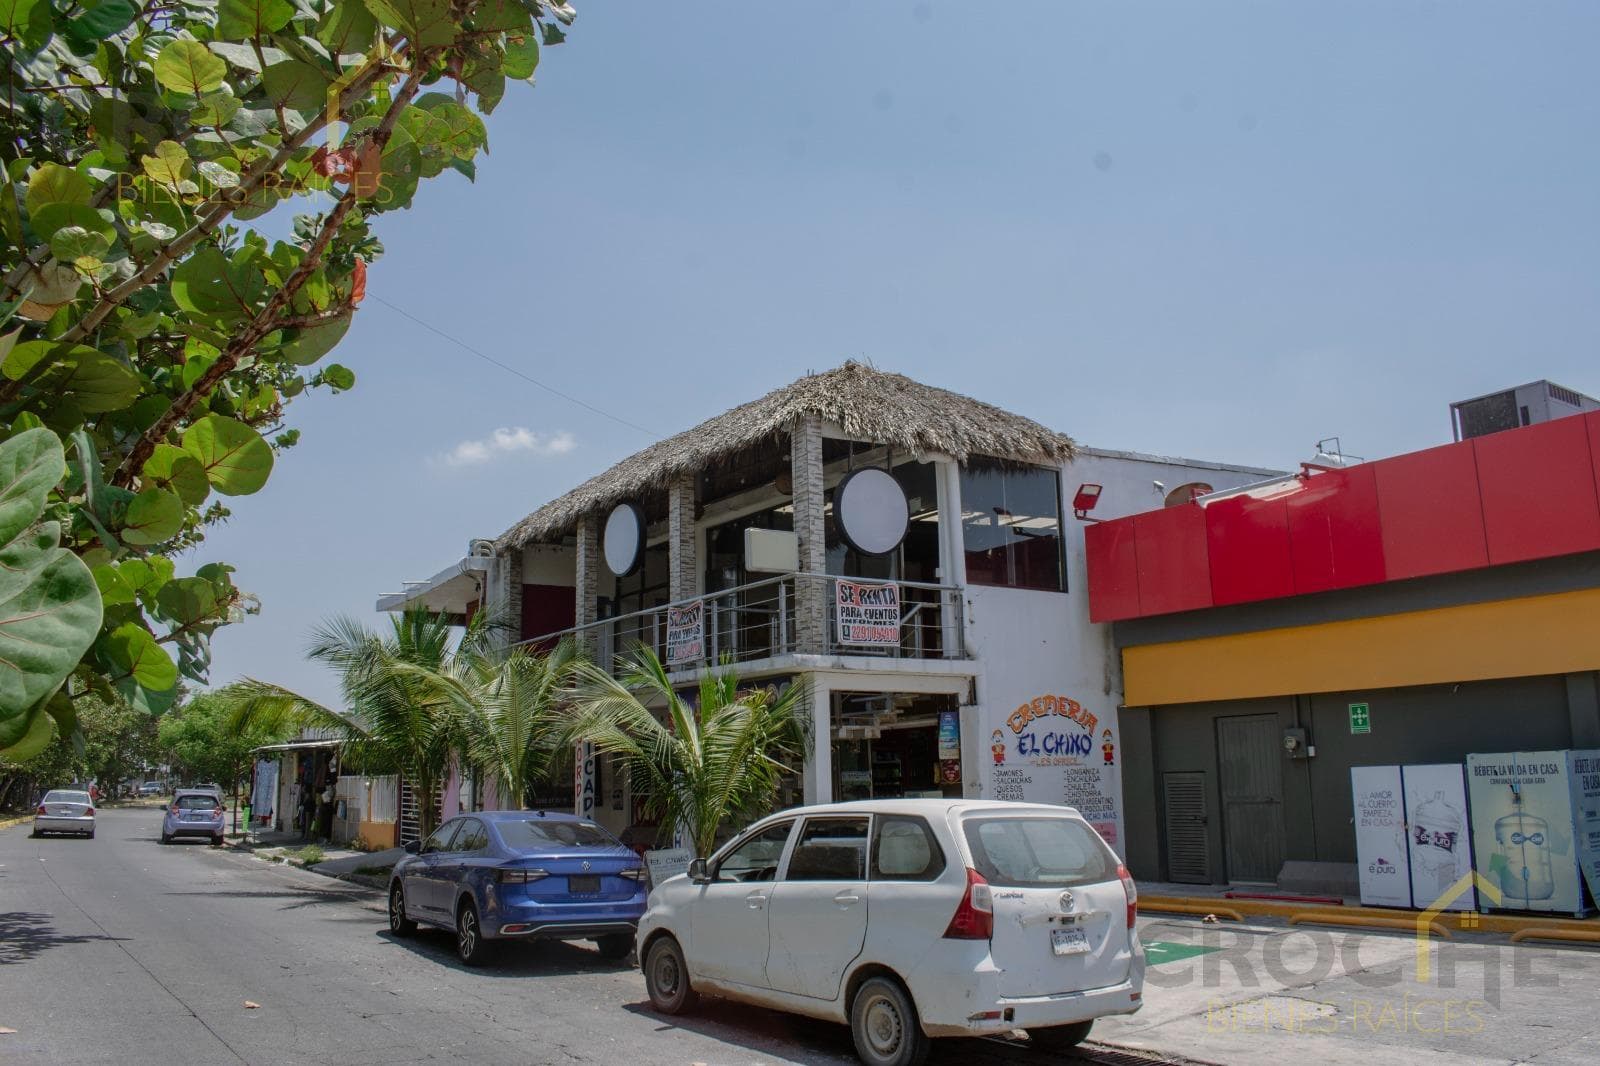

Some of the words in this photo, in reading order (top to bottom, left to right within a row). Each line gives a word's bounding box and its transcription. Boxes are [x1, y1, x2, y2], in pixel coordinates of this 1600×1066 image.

[840, 585, 854, 603] SE
[859, 588, 896, 605] RENTA
[840, 606, 862, 618] PARA
[864, 608, 898, 620] EVENTOS
[1007, 695, 1098, 736] CREMERIA
[1017, 733, 1040, 756] EL
[1043, 732, 1093, 757] CHINO
[1529, 764, 1538, 775] EN
[1540, 763, 1559, 774] CASA
[1370, 791, 1392, 799] AMOR
